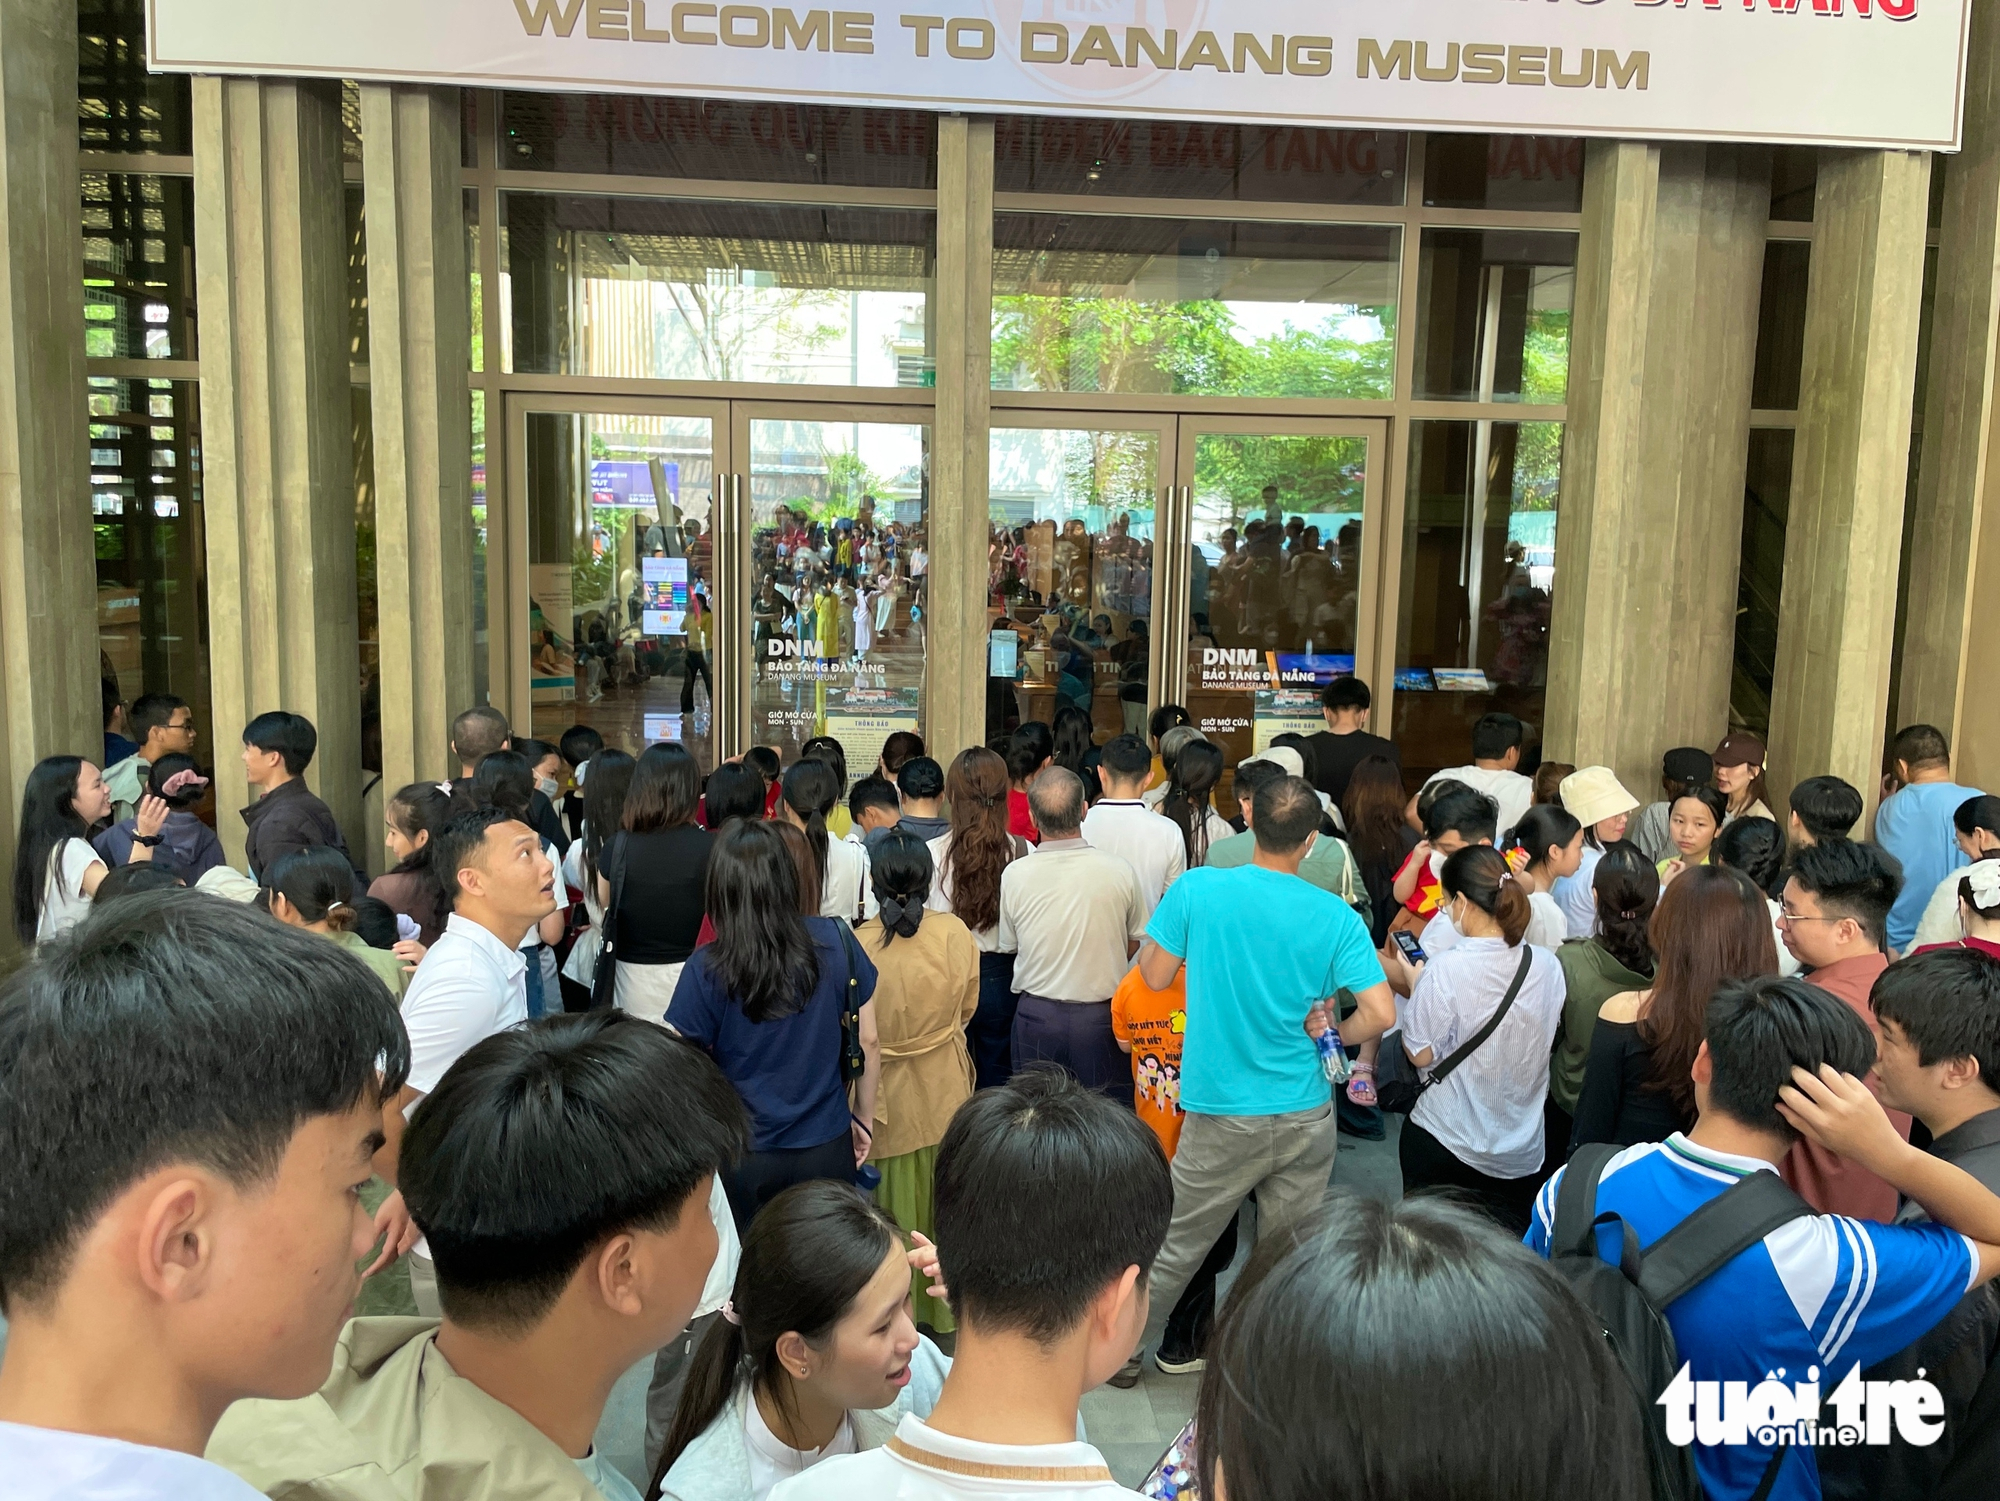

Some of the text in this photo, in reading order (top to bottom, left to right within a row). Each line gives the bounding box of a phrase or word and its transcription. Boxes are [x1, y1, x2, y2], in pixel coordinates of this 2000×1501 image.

[513, 0, 1651, 91] WELCOME TO DANANG MUSEUM
[768, 639, 824, 657] DNM
[1203, 648, 1257, 666] DNM
[768, 659, 886, 673] BẢO TÀNG ĐÀ NẴNG
[768, 673, 837, 681] DANANG MUSEUM
[1202, 667, 1316, 682] BẢO TÀNG ĐÀ NẴNG
[1236, 682, 1269, 690] MUSEUM
[768, 710, 785, 719] GIỜ
[1201, 717, 1216, 726] GIỜ
[1232, 717, 1249, 727] CỬA
